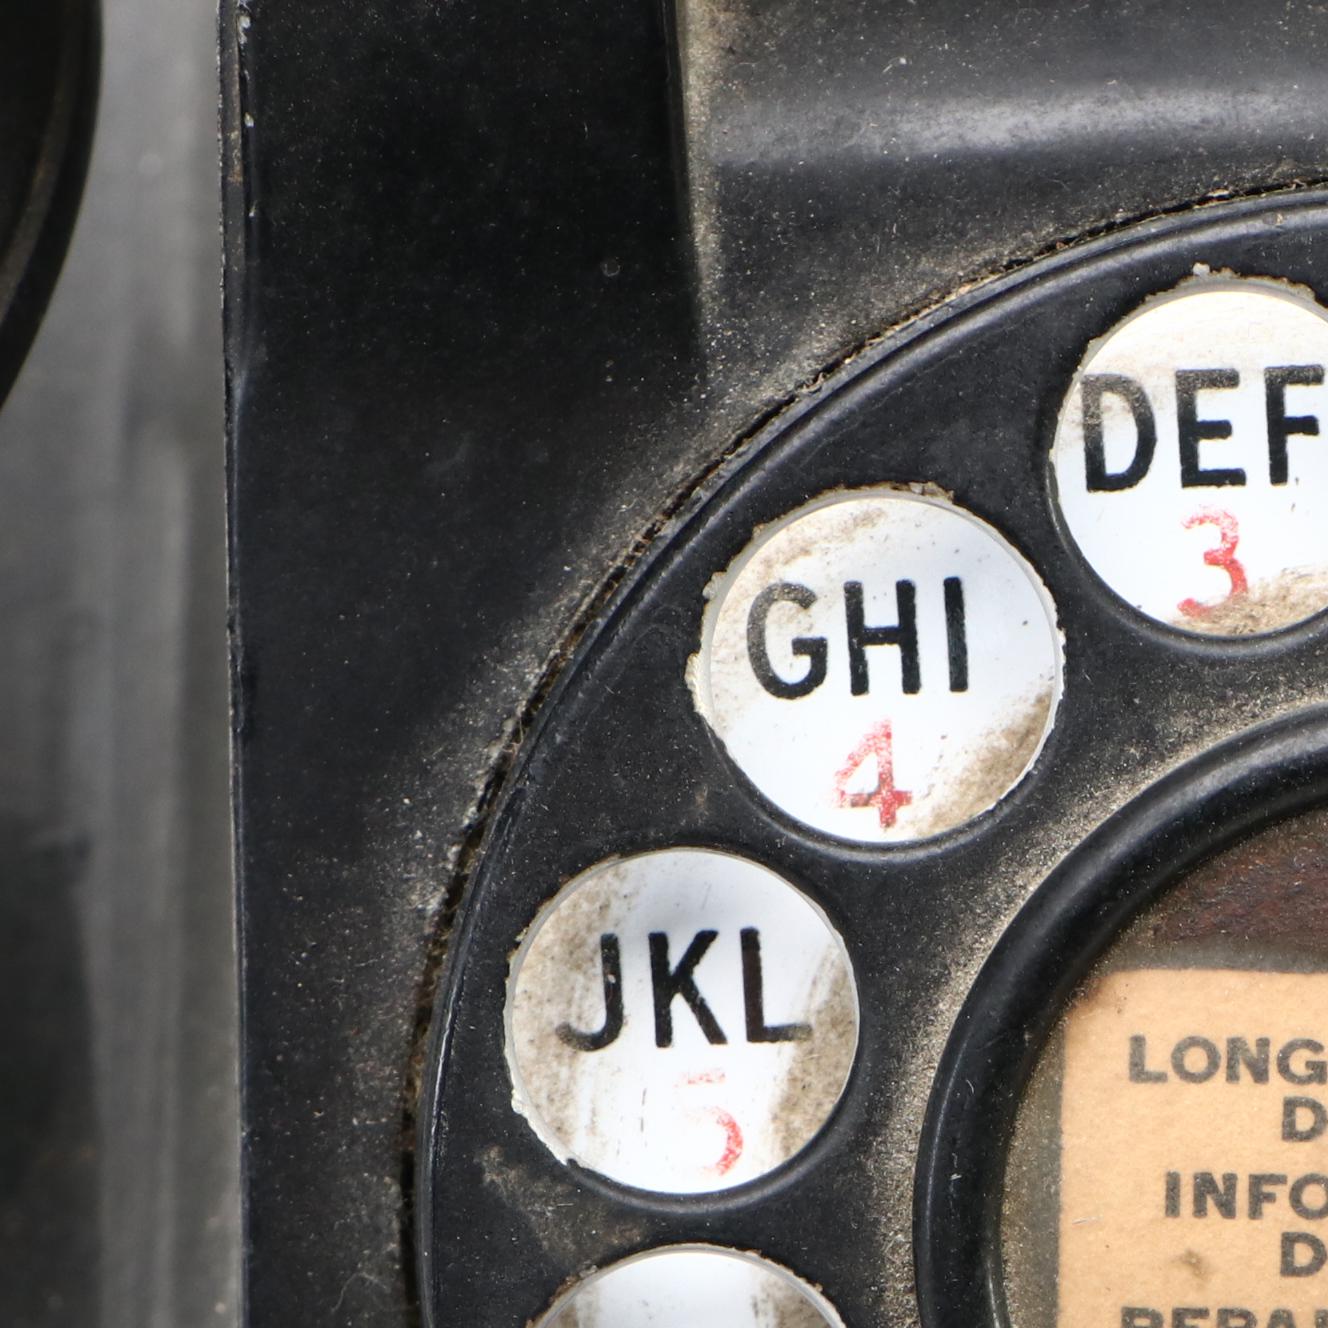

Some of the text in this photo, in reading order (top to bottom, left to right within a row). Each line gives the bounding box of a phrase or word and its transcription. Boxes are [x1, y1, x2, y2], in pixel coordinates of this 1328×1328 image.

[1079, 364, 1326, 494] DEF
[1177, 509, 1249, 619] 3
[746, 576, 971, 701] GHI
[834, 718, 914, 830] 4
[556, 927, 813, 1054] JKL
[1128, 1035, 1328, 1085] LONG
